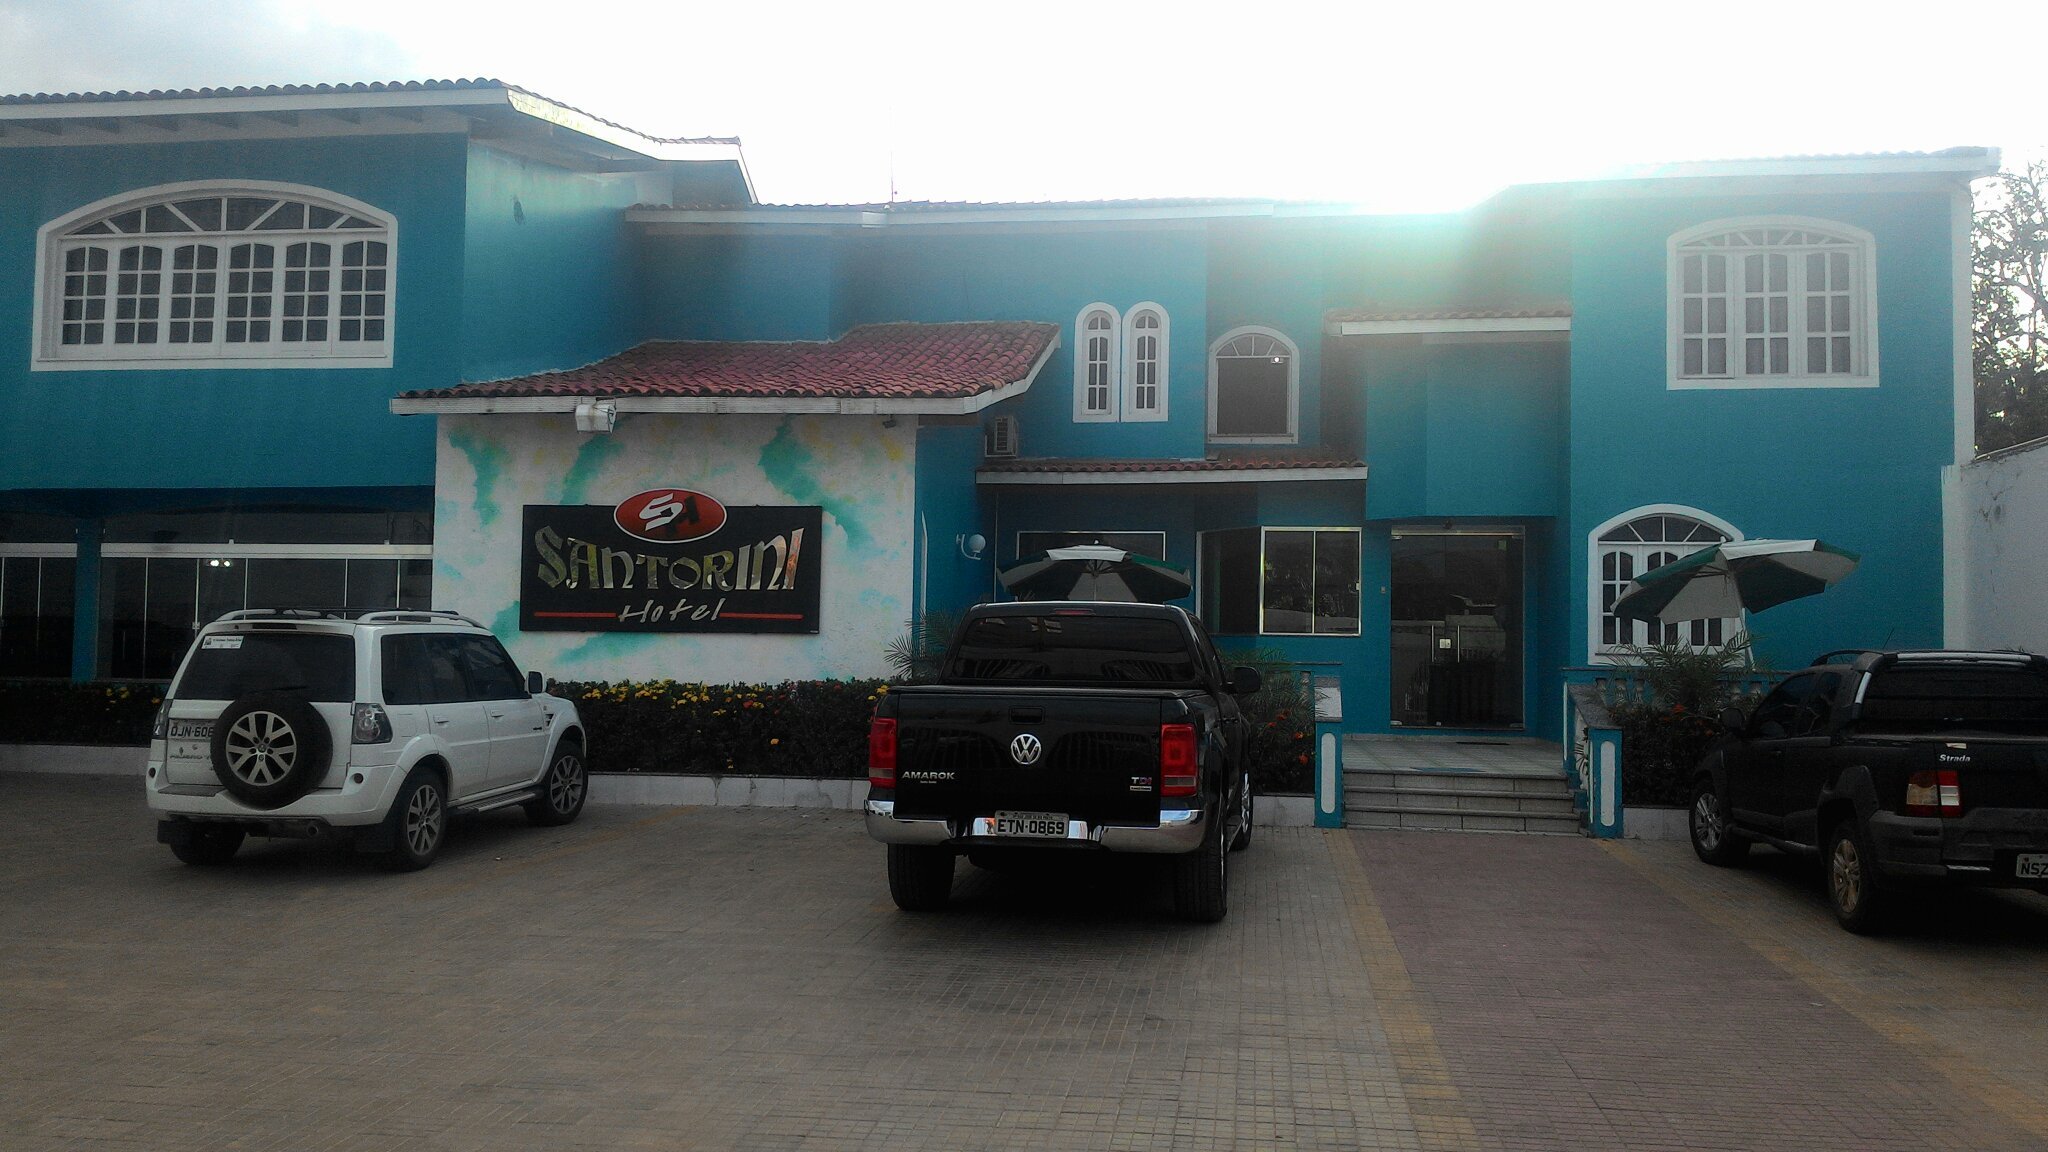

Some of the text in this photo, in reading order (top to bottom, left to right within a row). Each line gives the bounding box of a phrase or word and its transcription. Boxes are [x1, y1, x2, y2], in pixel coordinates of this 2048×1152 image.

[534, 525, 805, 592] SANTORINI
[618, 597, 727, 624] Hotel
[1939, 754, 1971, 762] Strada
[902, 771, 955, 780] AMAROK
